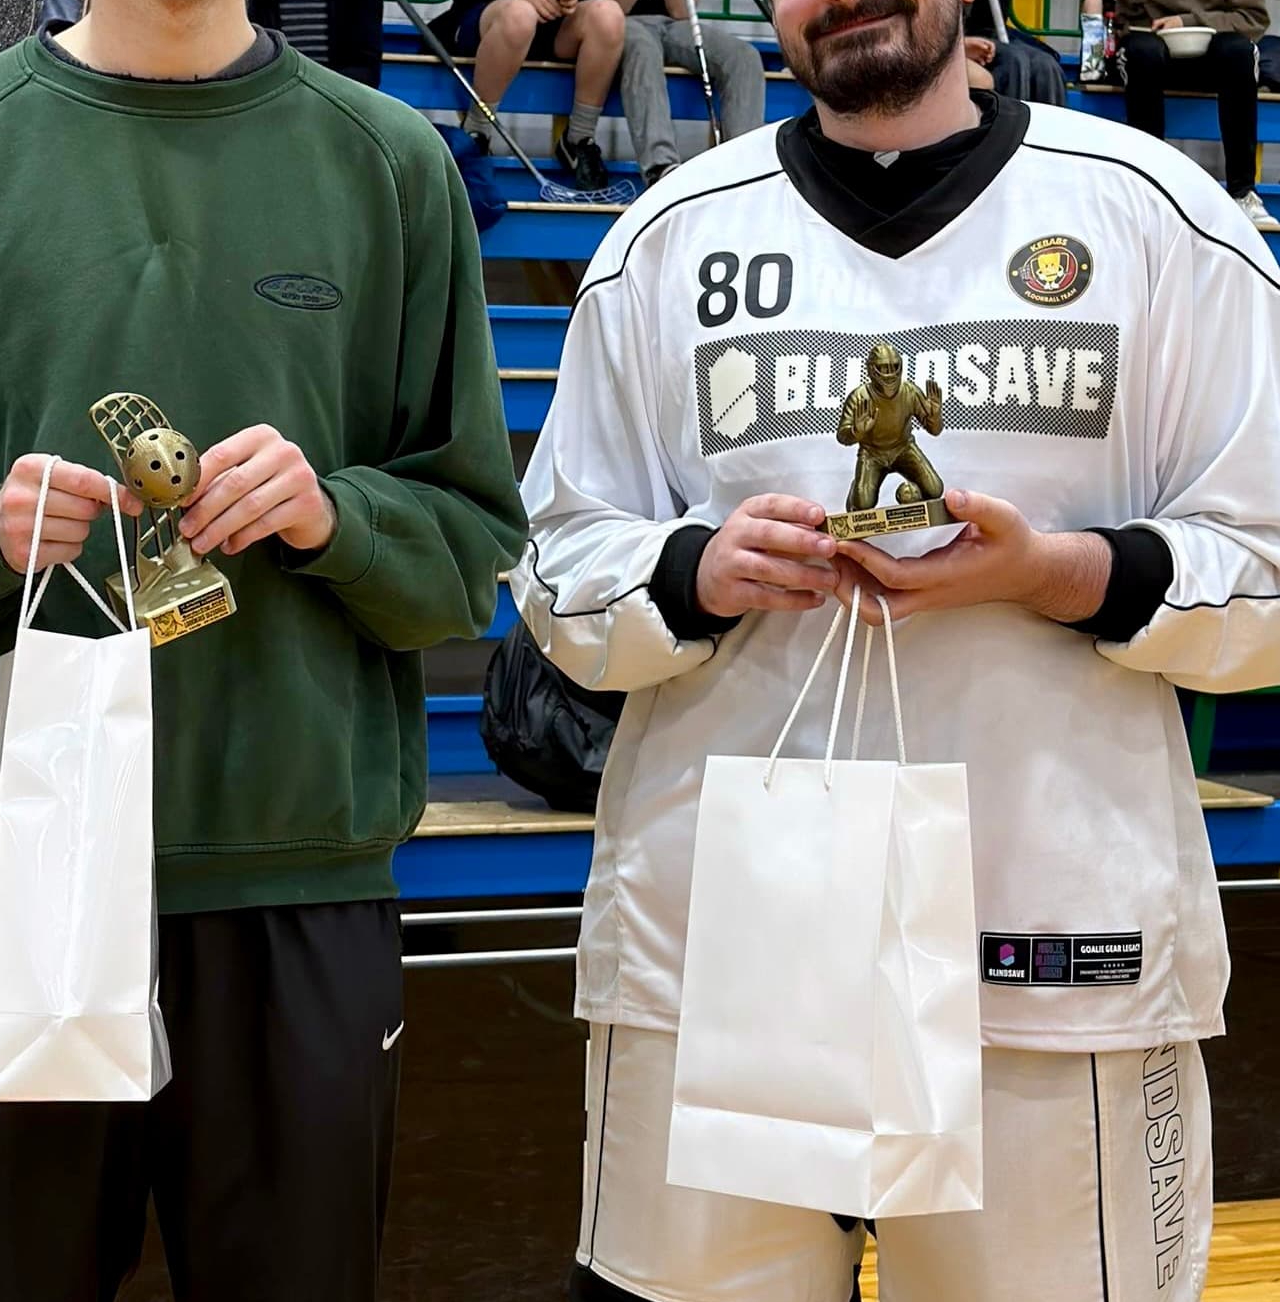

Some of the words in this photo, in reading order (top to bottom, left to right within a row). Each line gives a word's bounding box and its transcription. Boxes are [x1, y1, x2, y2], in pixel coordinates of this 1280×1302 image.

[1030, 237, 1068, 252] KEBABS
[697, 251, 794, 328] 80
[1024, 290, 1060, 303] FLOORBALL
[1060, 288, 1077, 300] TEAM
[774, 343, 1106, 415] BLIDSAVE
[1080, 945, 1105, 954] GOALIE
[1105, 944, 1122, 953] GEAR
[988, 968, 1025, 978] BLINDSAVE
